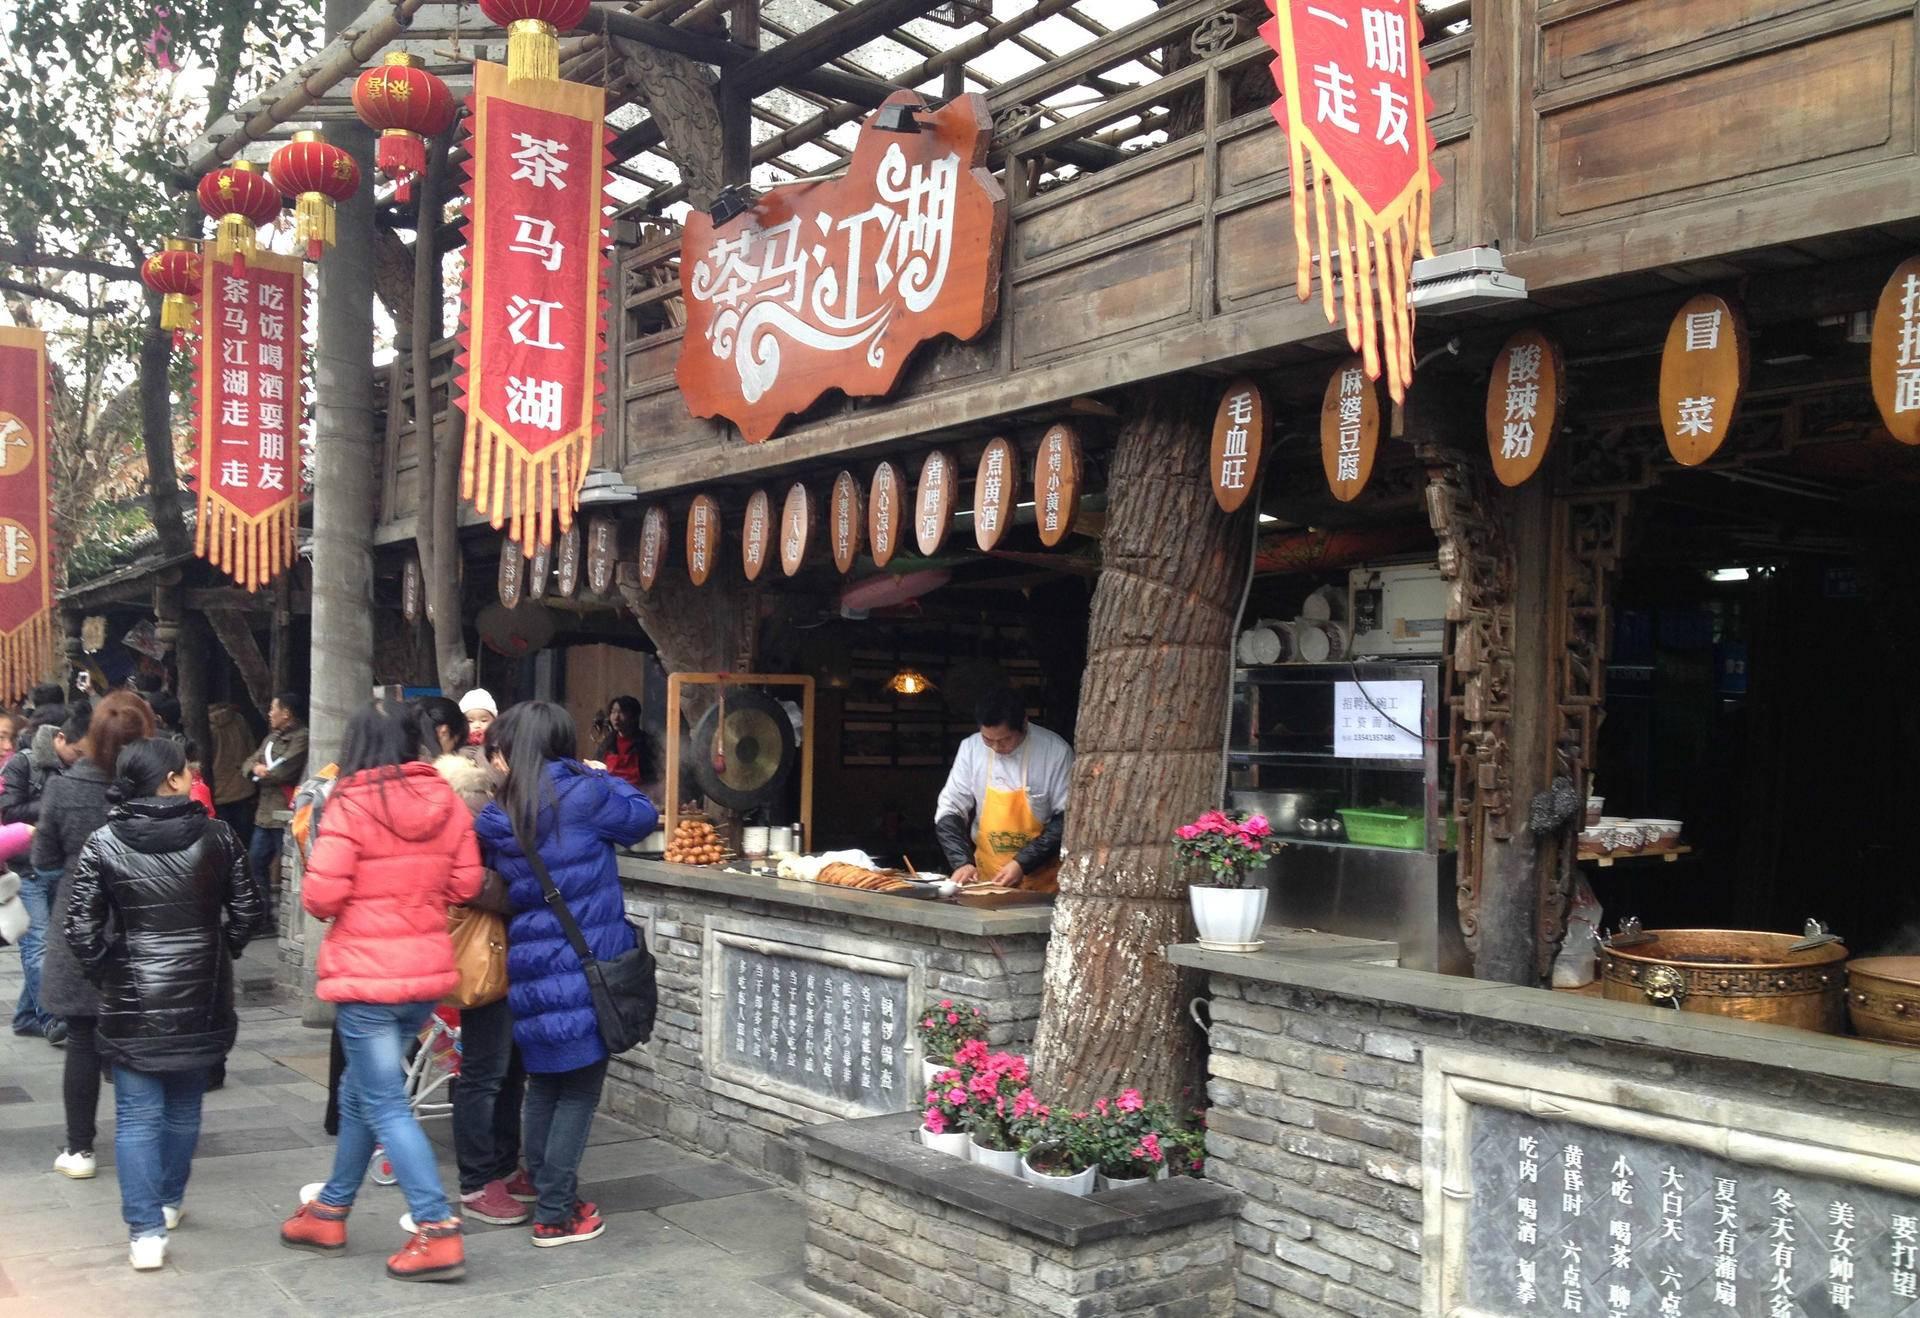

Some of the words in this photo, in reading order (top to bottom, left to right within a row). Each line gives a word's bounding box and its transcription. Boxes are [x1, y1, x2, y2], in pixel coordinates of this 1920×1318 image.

[1307, 6, 1360, 134] 一走
[1361, 7, 1410, 155] 朋友
[504, 132, 569, 432] 茶马江湖
[692, 142, 961, 403] 茶马江湖
[220, 276, 249, 489] 茶马江湖走一走
[257, 284, 284, 491] 吃饭喝酒耍朋友
[1337, 368, 1362, 481] 麻婆豆腐
[1501, 344, 1541, 459] 酸辣粉
[1676, 309, 1722, 438] 冒菜
[981, 448, 1004, 532] 煮黄酒
[1221, 391, 1253, 489] 毛血旺
[922, 458, 943, 538] 煮啤酒
[1518, 1136, 1539, 1183] 吃肉
[1563, 1144, 1585, 1217] 黄昏时
[1611, 1154, 1634, 1205] 小吃
[1661, 1166, 1685, 1242] 大白天
[1517, 1197, 1538, 1245] 喝酒
[1609, 1220, 1632, 1269] 喝茶
[1713, 1176, 1739, 1307] 夏天有蒲扇
[1828, 1201, 1856, 1310] 美女帅哥
[1561, 1239, 1583, 1313] 六点后
[1659, 1265, 1683, 1318] 六点
